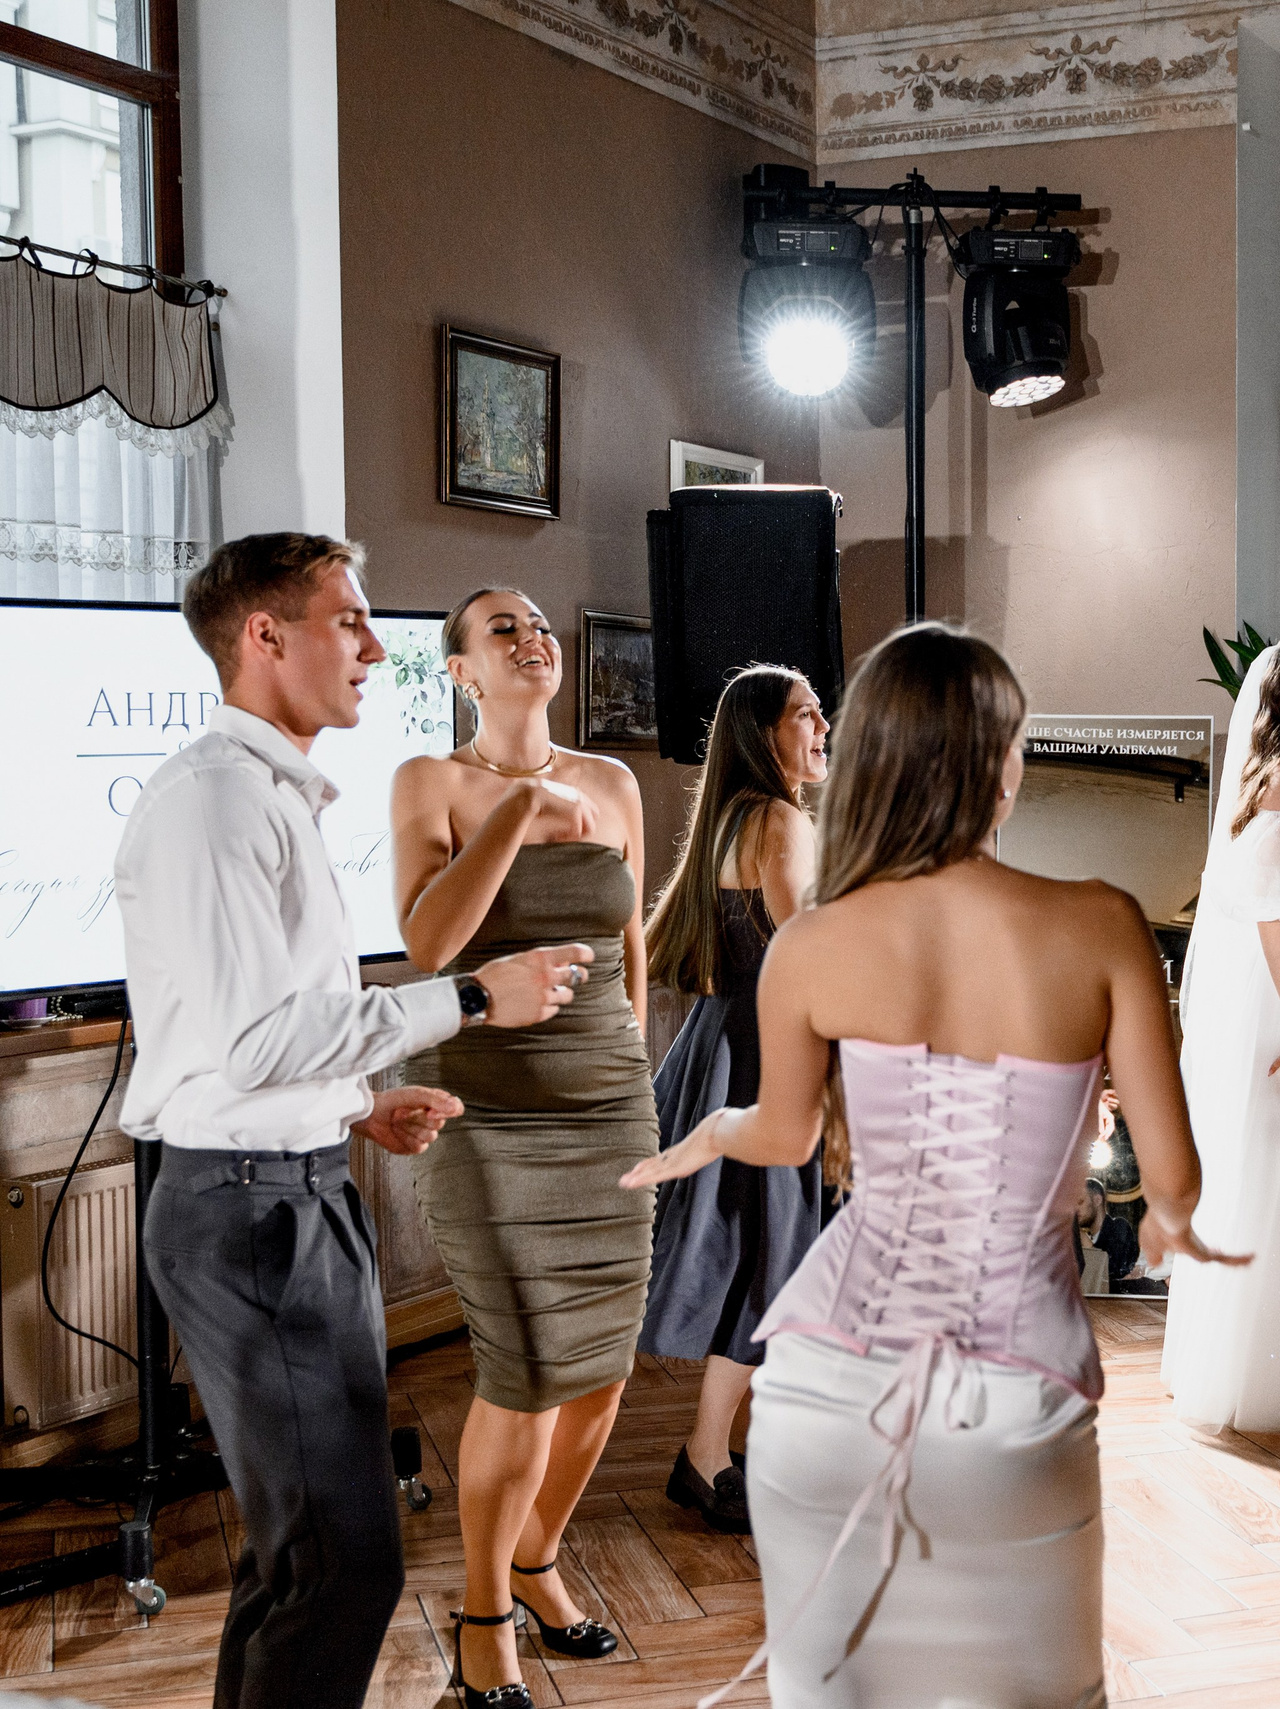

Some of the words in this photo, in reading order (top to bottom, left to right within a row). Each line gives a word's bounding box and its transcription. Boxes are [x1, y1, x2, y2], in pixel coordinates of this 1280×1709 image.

[87, 687, 220, 735] АНДР
[1053, 727, 1114, 739] СЧАСТЬЕ
[1116, 728, 1205, 741] ИЗМЕРЯЕТСЯ
[1033, 742, 1098, 754] ВАШИМИ
[1100, 744, 1178, 756] УЛЫБКАМИ
